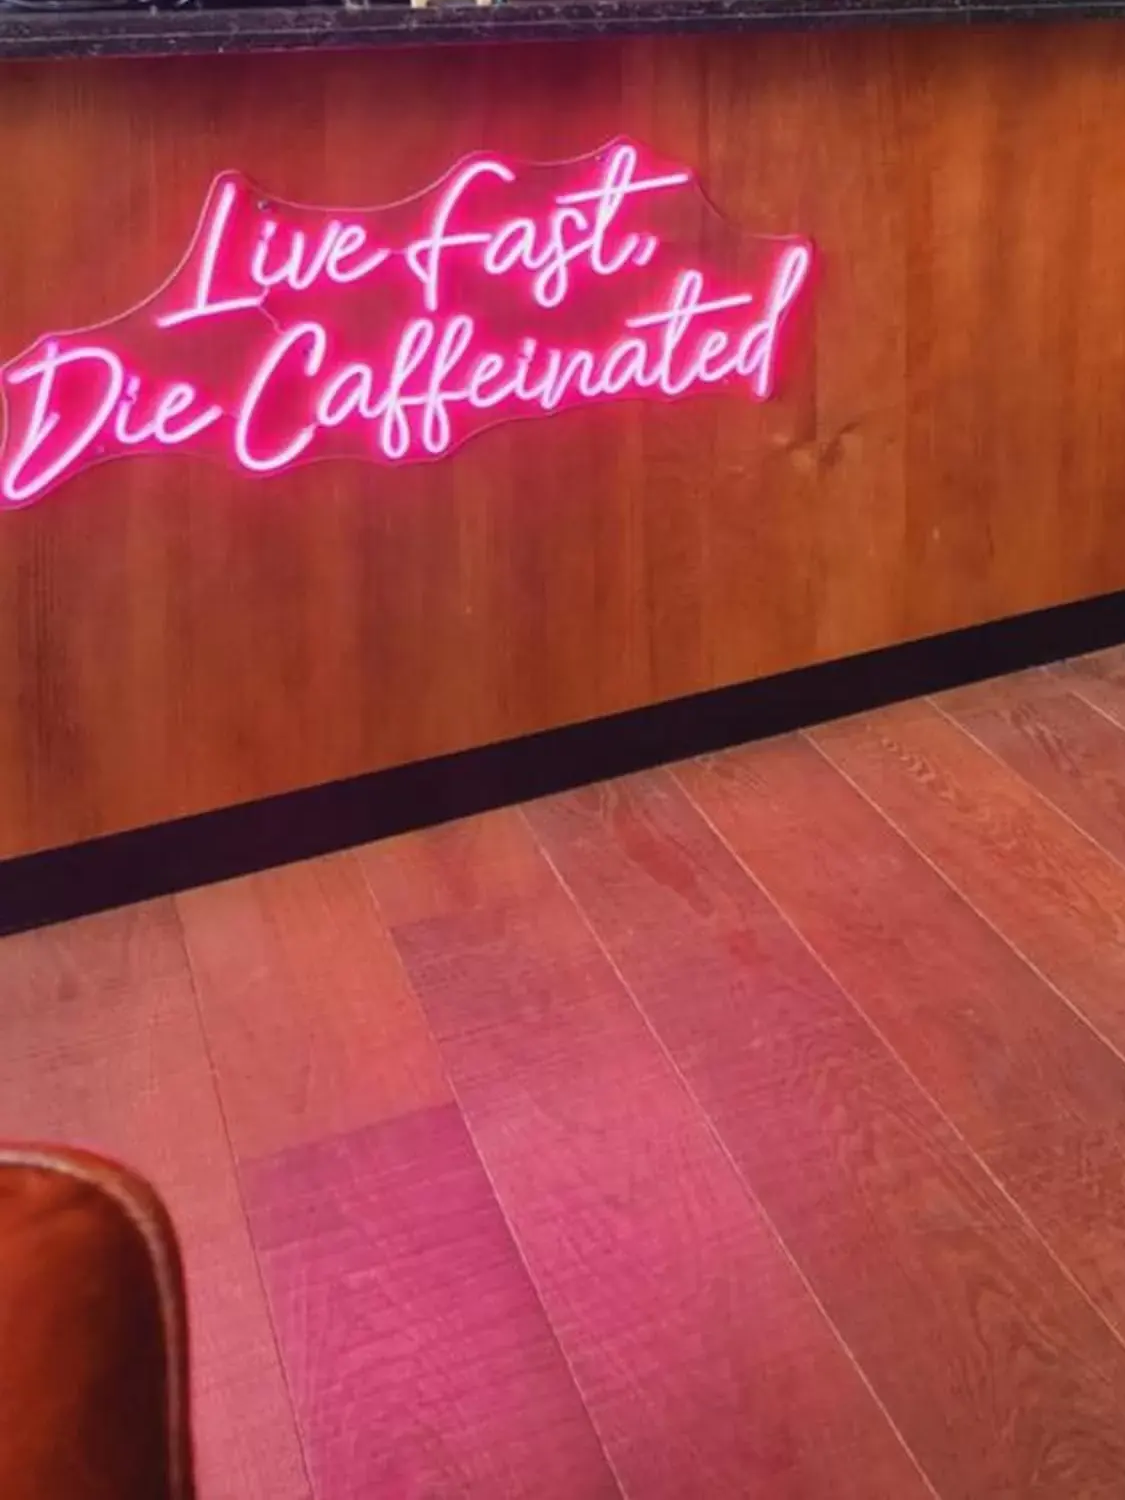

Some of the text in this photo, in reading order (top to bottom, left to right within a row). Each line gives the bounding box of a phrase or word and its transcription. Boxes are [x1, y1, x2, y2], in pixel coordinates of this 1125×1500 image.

[155, 181, 392, 328] Live
[3, 245, 809, 500] Die Caffeinated
